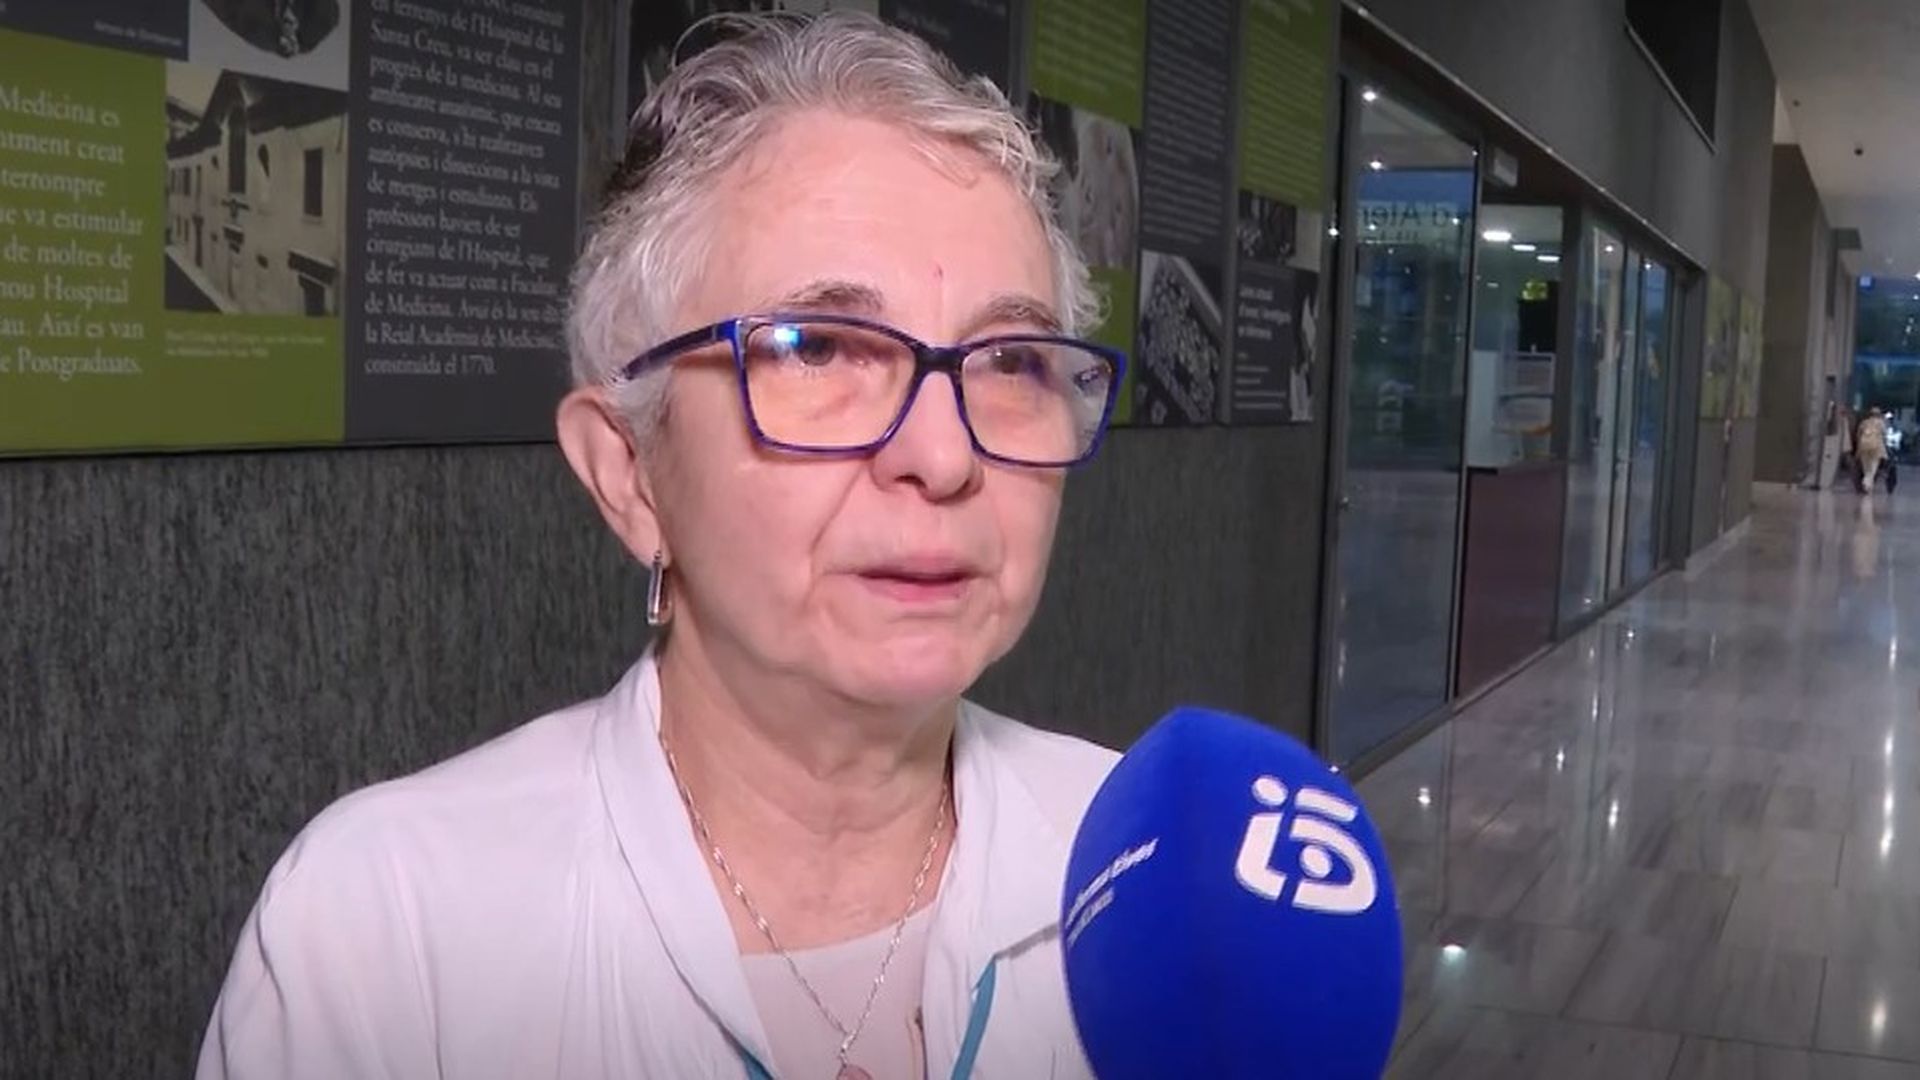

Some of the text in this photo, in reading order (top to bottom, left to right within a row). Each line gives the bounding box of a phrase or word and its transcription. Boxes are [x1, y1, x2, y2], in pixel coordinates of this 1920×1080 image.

[371, 18, 410, 48] Santa
[474, 49, 493, 65] ser
[451, 9, 469, 32] de
[470, 13, 533, 50] l'Hospital
[535, 29, 551, 51] de
[552, 32, 565, 55] la
[425, 61, 442, 84] de
[445, 64, 458, 87] la
[526, 82, 541, 105] Al
[367, 117, 383, 133] es
[77, 141, 125, 165] creat
[366, 167, 384, 194] de
[521, 163, 532, 184] la
[23, 208, 46, 226] va
[52, 207, 143, 236] estimular
[484, 214, 502, 237] de
[4, 233, 134, 270] de moltes de
[438, 238, 454, 261] de
[365, 260, 383, 284] de
[386, 261, 405, 285] fet
[408, 270, 424, 287] va
[469, 275, 498, 292] com
[43, 273, 129, 311] Hospital
[364, 290, 384, 316] de
[386, 291, 455, 318] Medicina.
[506, 298, 517, 320] la
[86, 322, 105, 338] es
[109, 321, 145, 339] van
[365, 320, 378, 345] la
[380, 321, 415, 346] Reial
[481, 325, 496, 348] de
[444, 350, 457, 375] el
